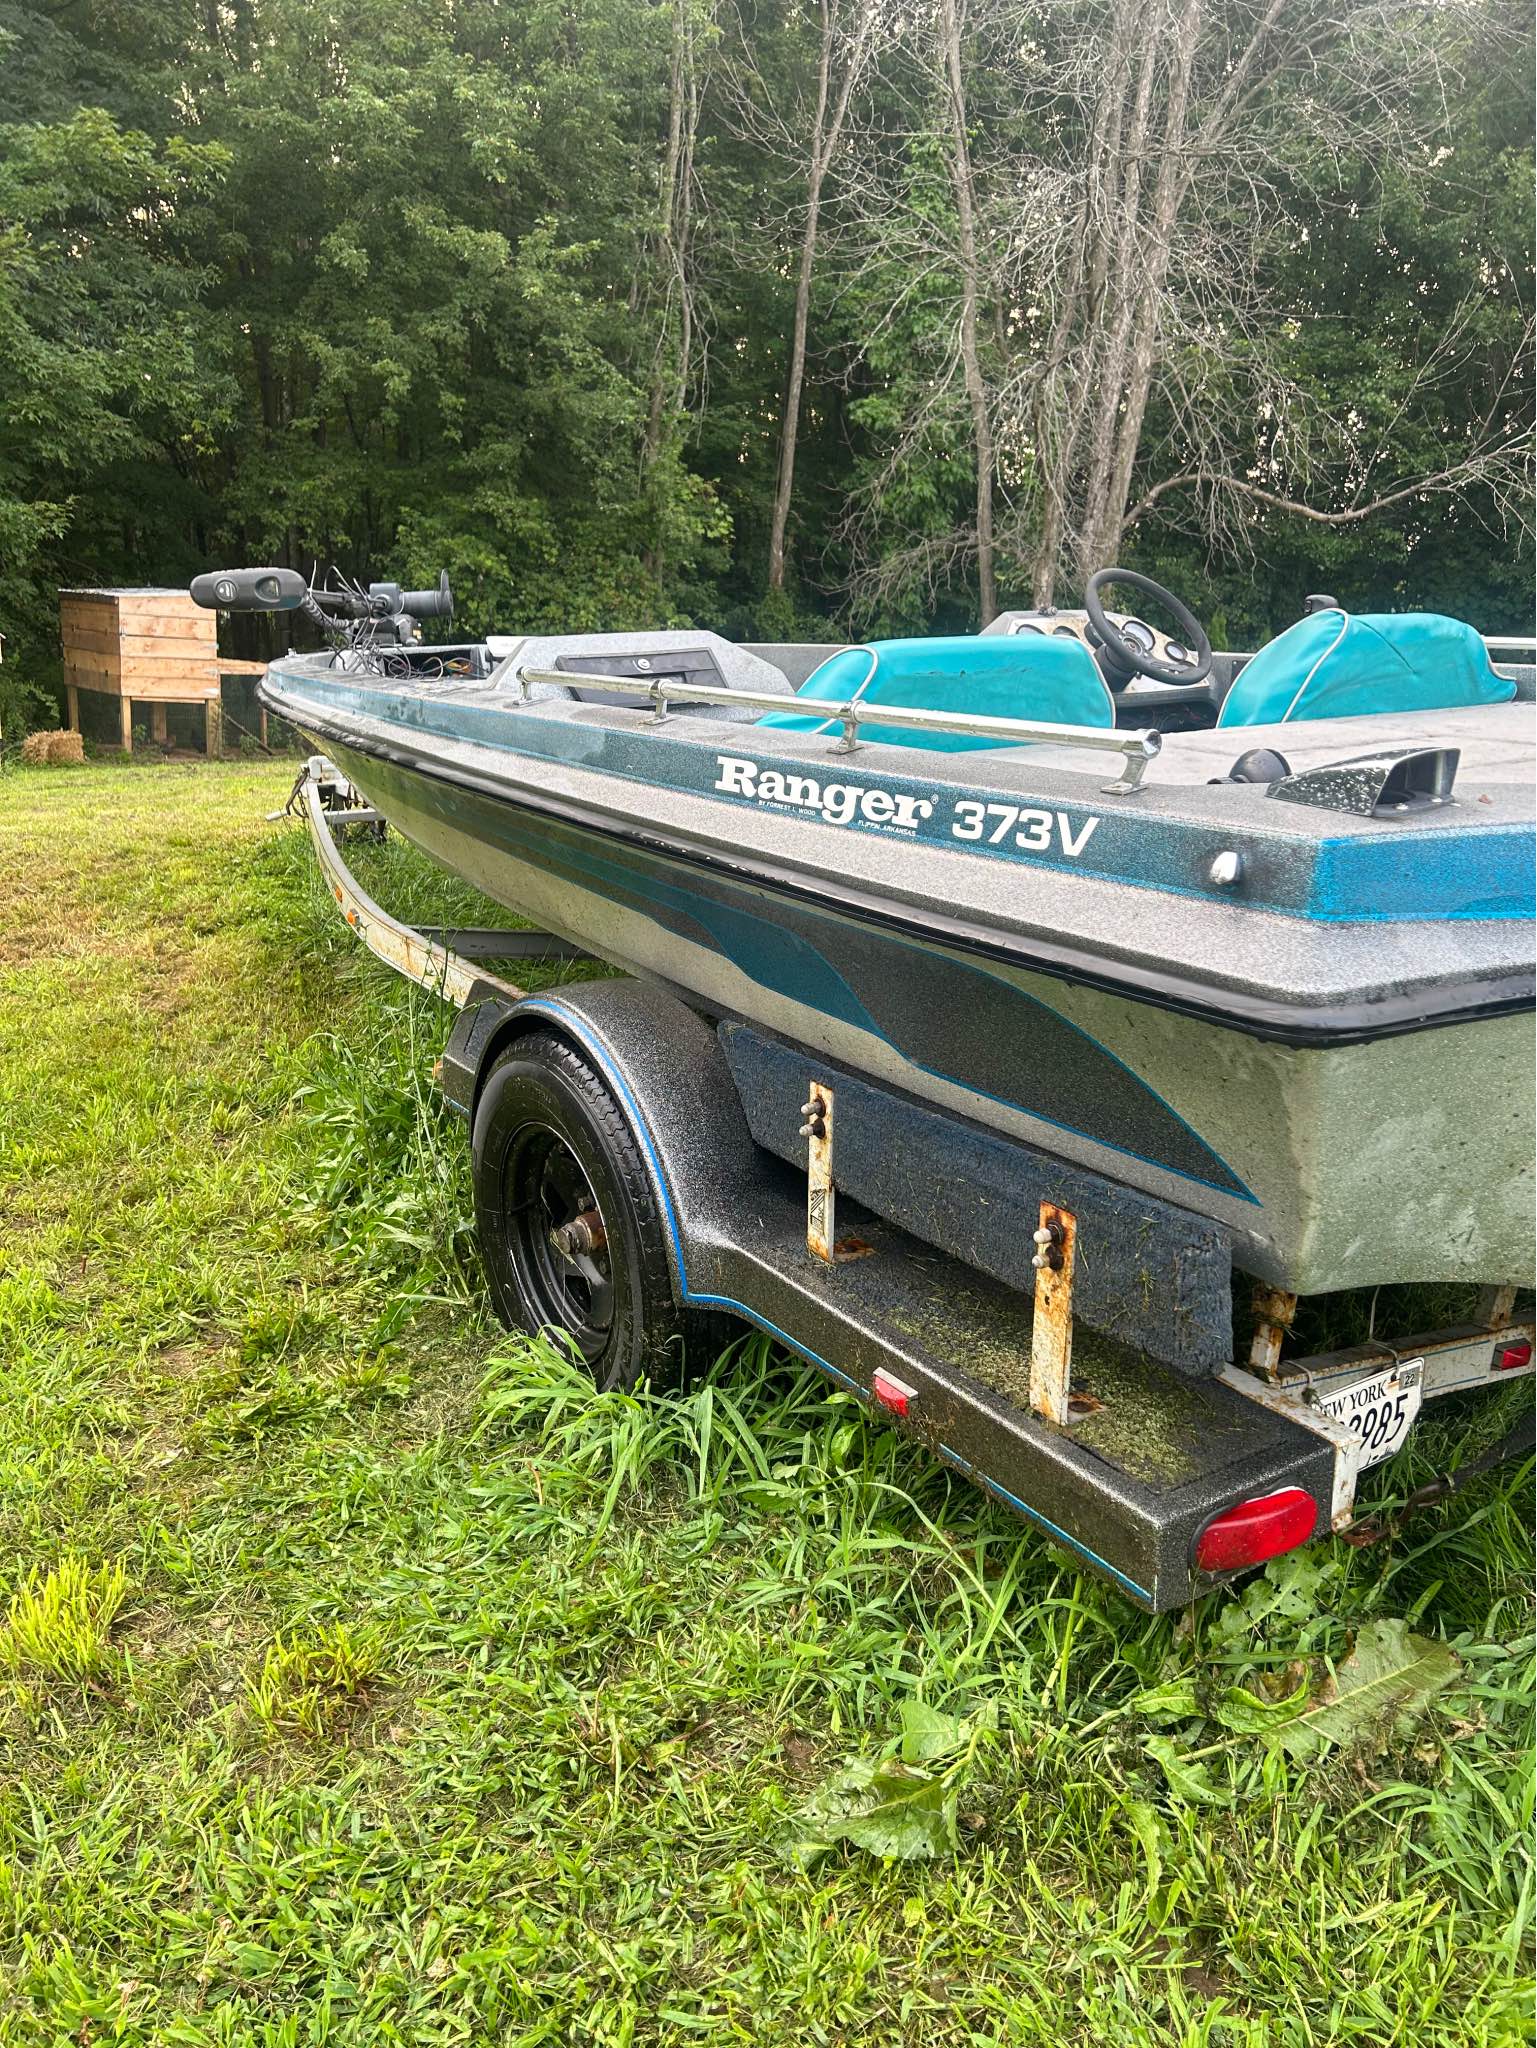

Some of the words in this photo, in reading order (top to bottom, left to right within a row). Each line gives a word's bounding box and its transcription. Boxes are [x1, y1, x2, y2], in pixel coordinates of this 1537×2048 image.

[714, 755, 932, 826] Ranger
[951, 800, 1100, 857] 373V
[766, 801, 791, 810] FORREST
[798, 807, 816, 816] WOOD
[883, 825, 916, 836] ARKANSAS
[1404, 1373, 1415, 1385] 22
[1349, 1379, 1387, 1410] YORK
